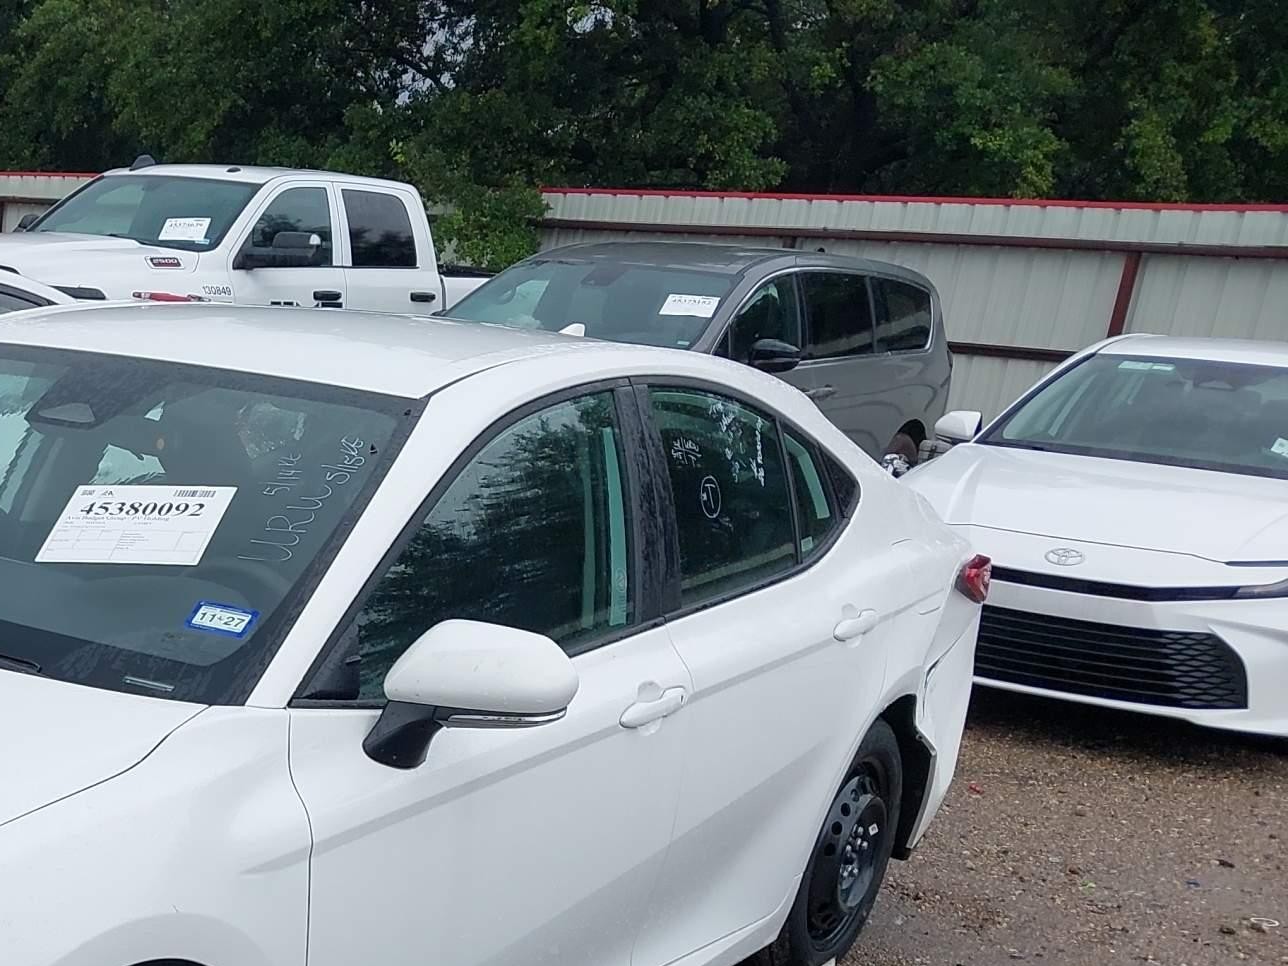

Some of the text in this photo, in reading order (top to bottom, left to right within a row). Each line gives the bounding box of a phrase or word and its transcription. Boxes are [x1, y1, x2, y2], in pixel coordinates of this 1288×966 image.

[202, 285, 232, 297] 130849
[80, 501, 205, 517] 45380092
[222, 616, 246, 628] 27
